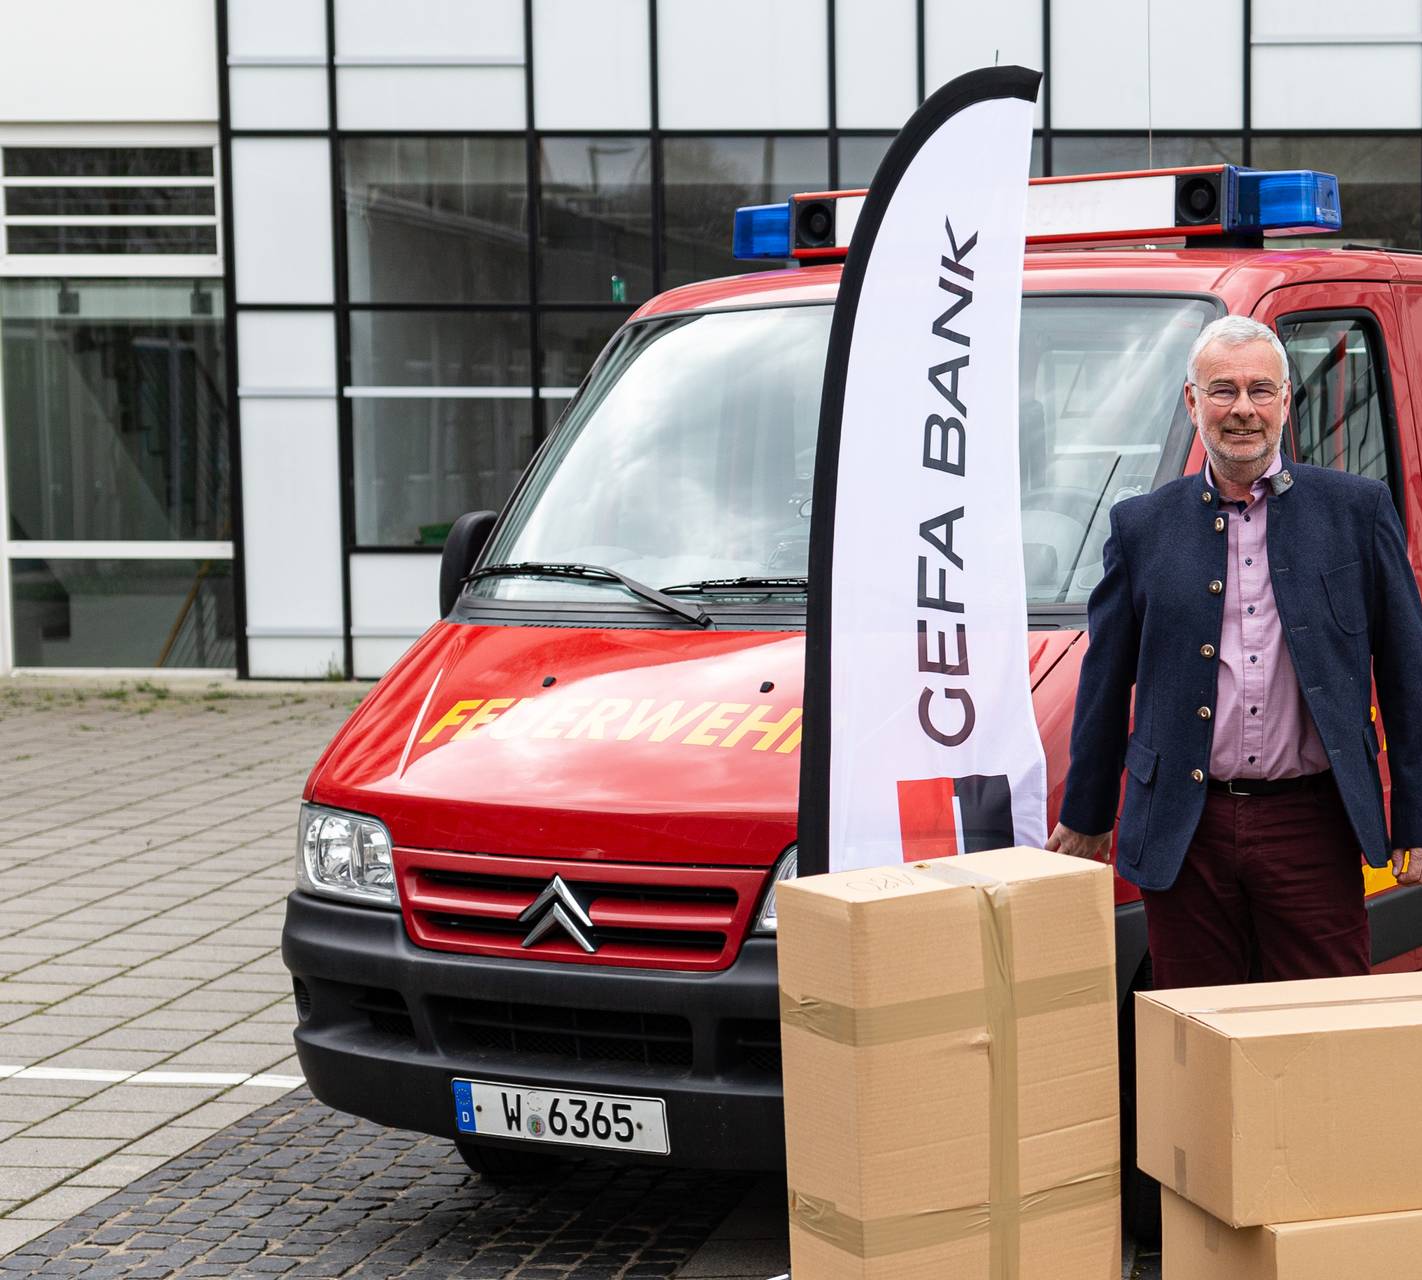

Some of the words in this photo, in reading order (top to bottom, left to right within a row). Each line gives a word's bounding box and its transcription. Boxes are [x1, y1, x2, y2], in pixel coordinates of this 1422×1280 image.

[922, 214, 978, 477] BANK
[917, 505, 976, 747] GEFA
[419, 698, 803, 754] FEUERWEH
[461, 1111, 471, 1123] D
[501, 1092, 522, 1132] W
[549, 1098, 634, 1143] 6365
